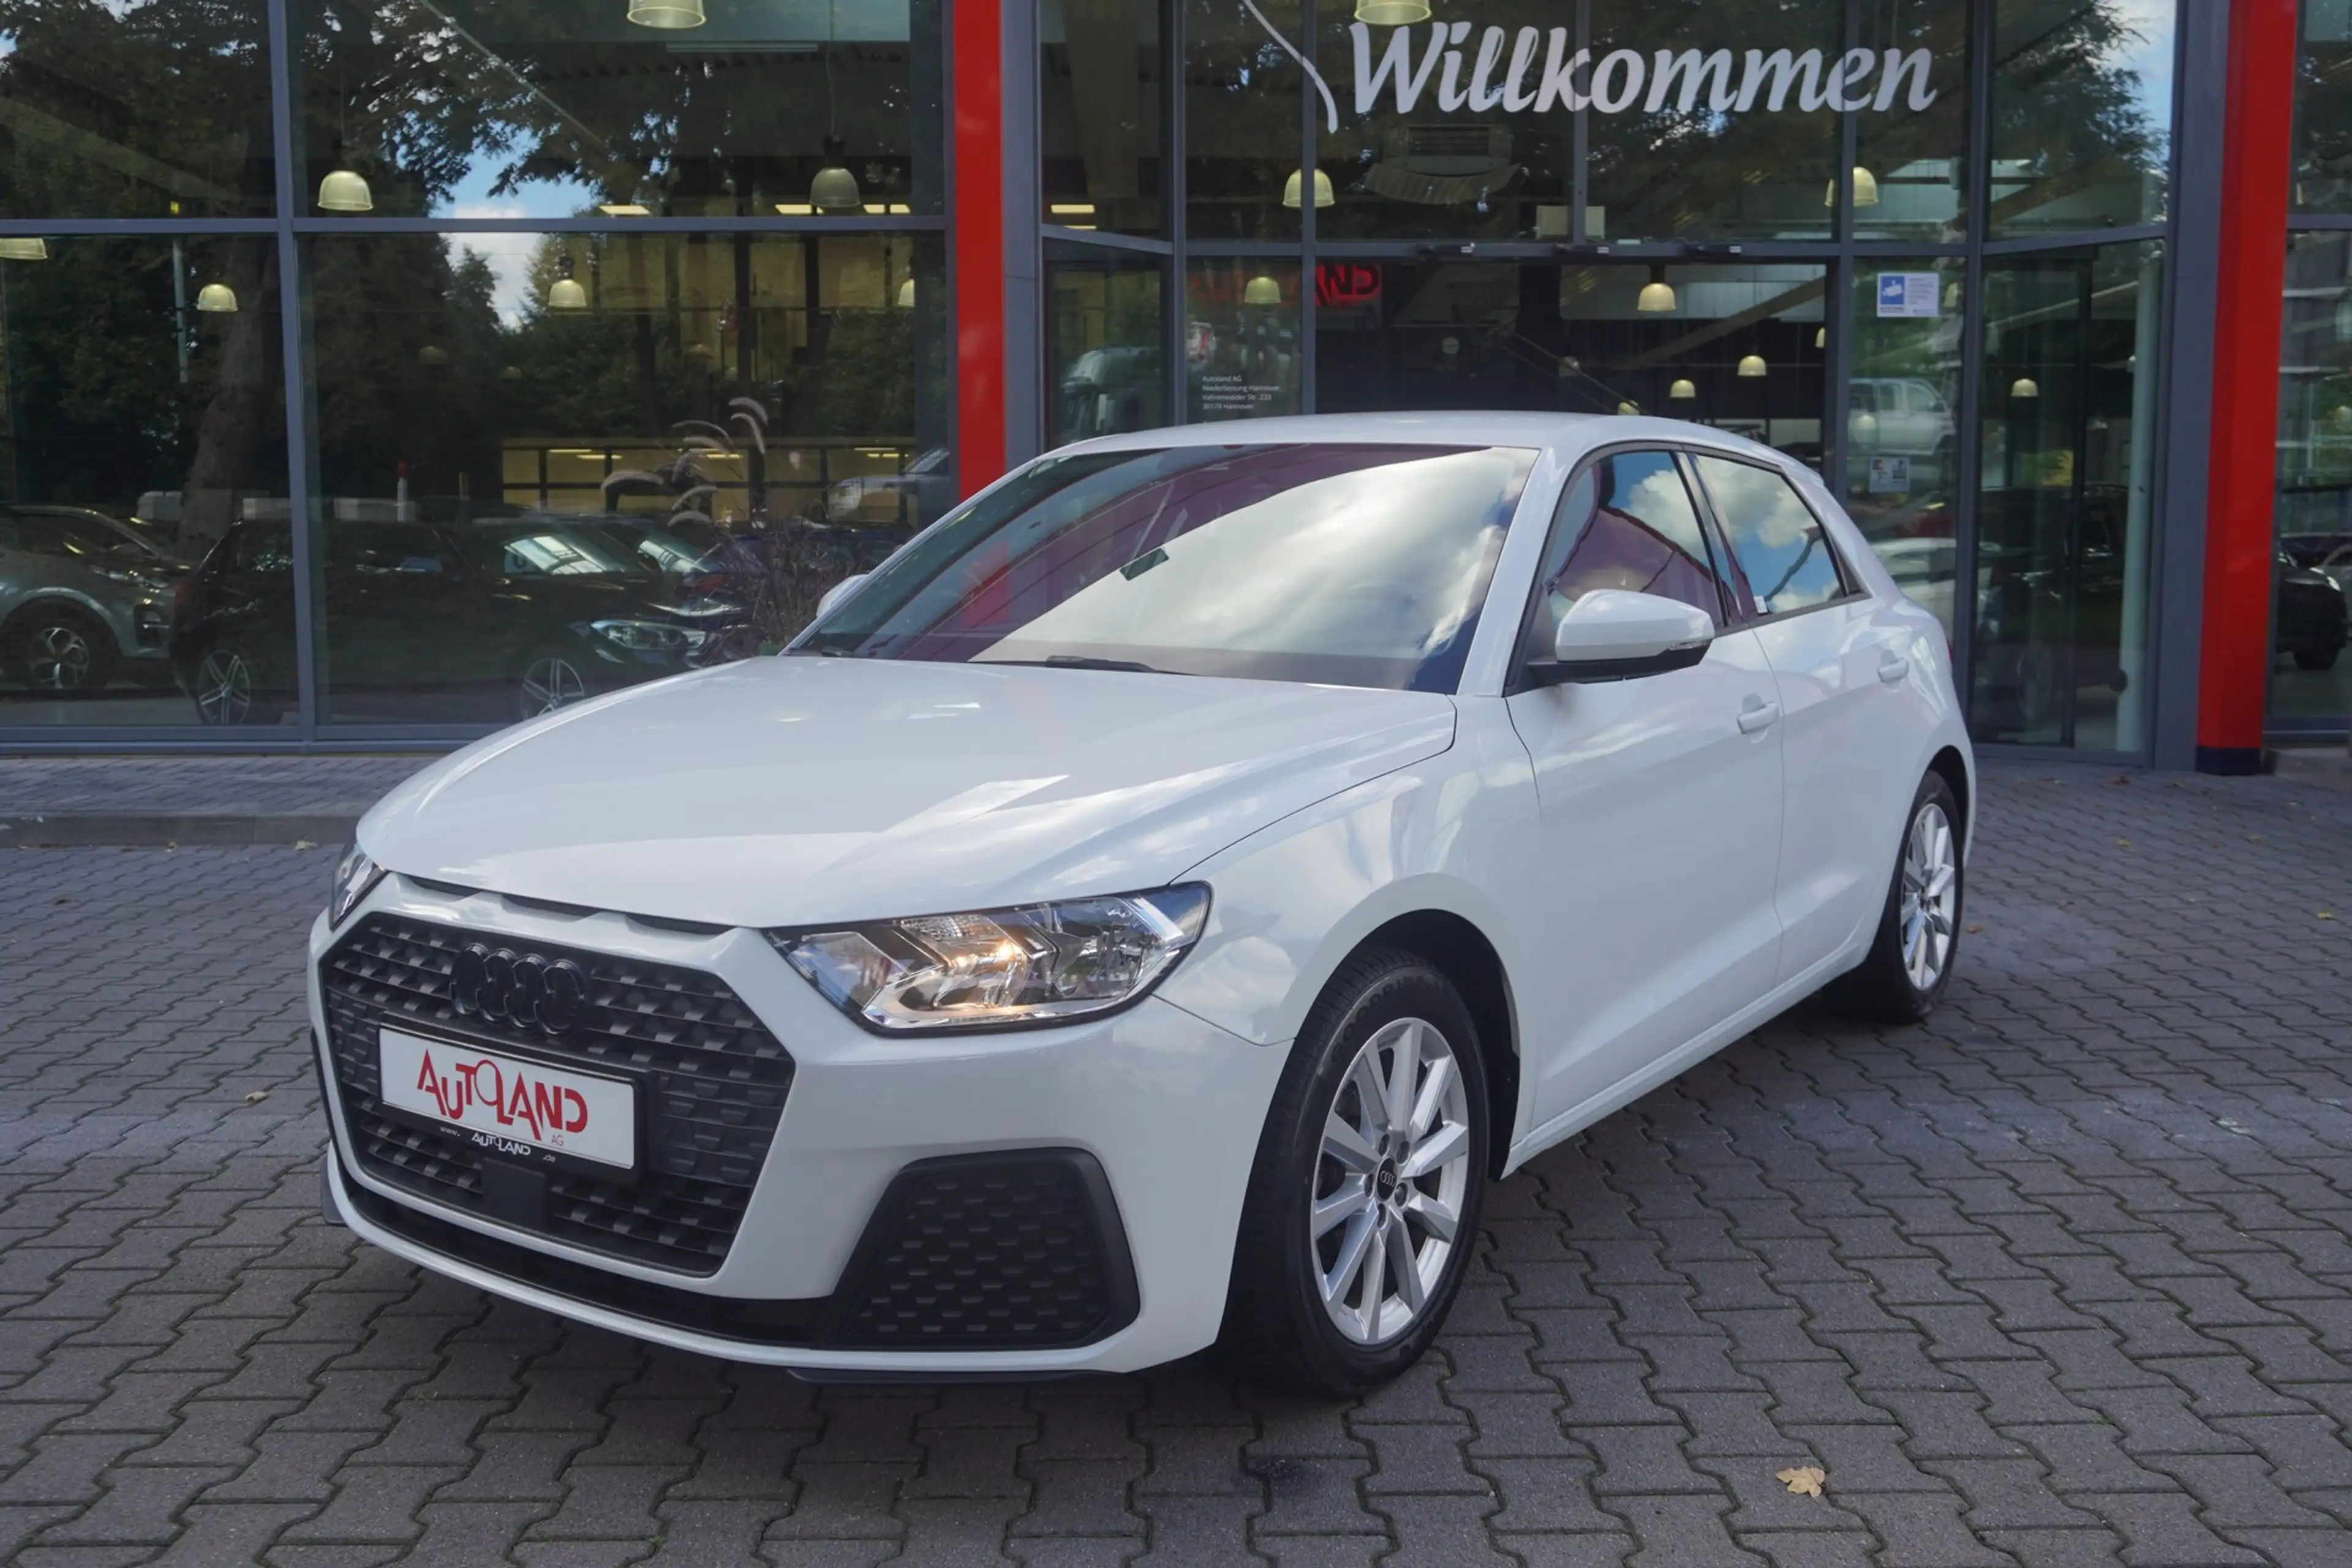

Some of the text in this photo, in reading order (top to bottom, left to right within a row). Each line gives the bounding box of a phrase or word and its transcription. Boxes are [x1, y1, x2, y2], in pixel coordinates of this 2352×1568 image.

[1348, 21, 1937, 114] Willkommen
[417, 1049, 588, 1141] AUTOLAND
[472, 1132, 531, 1156] AUTOLAND
[551, 1134, 564, 1147] AG
